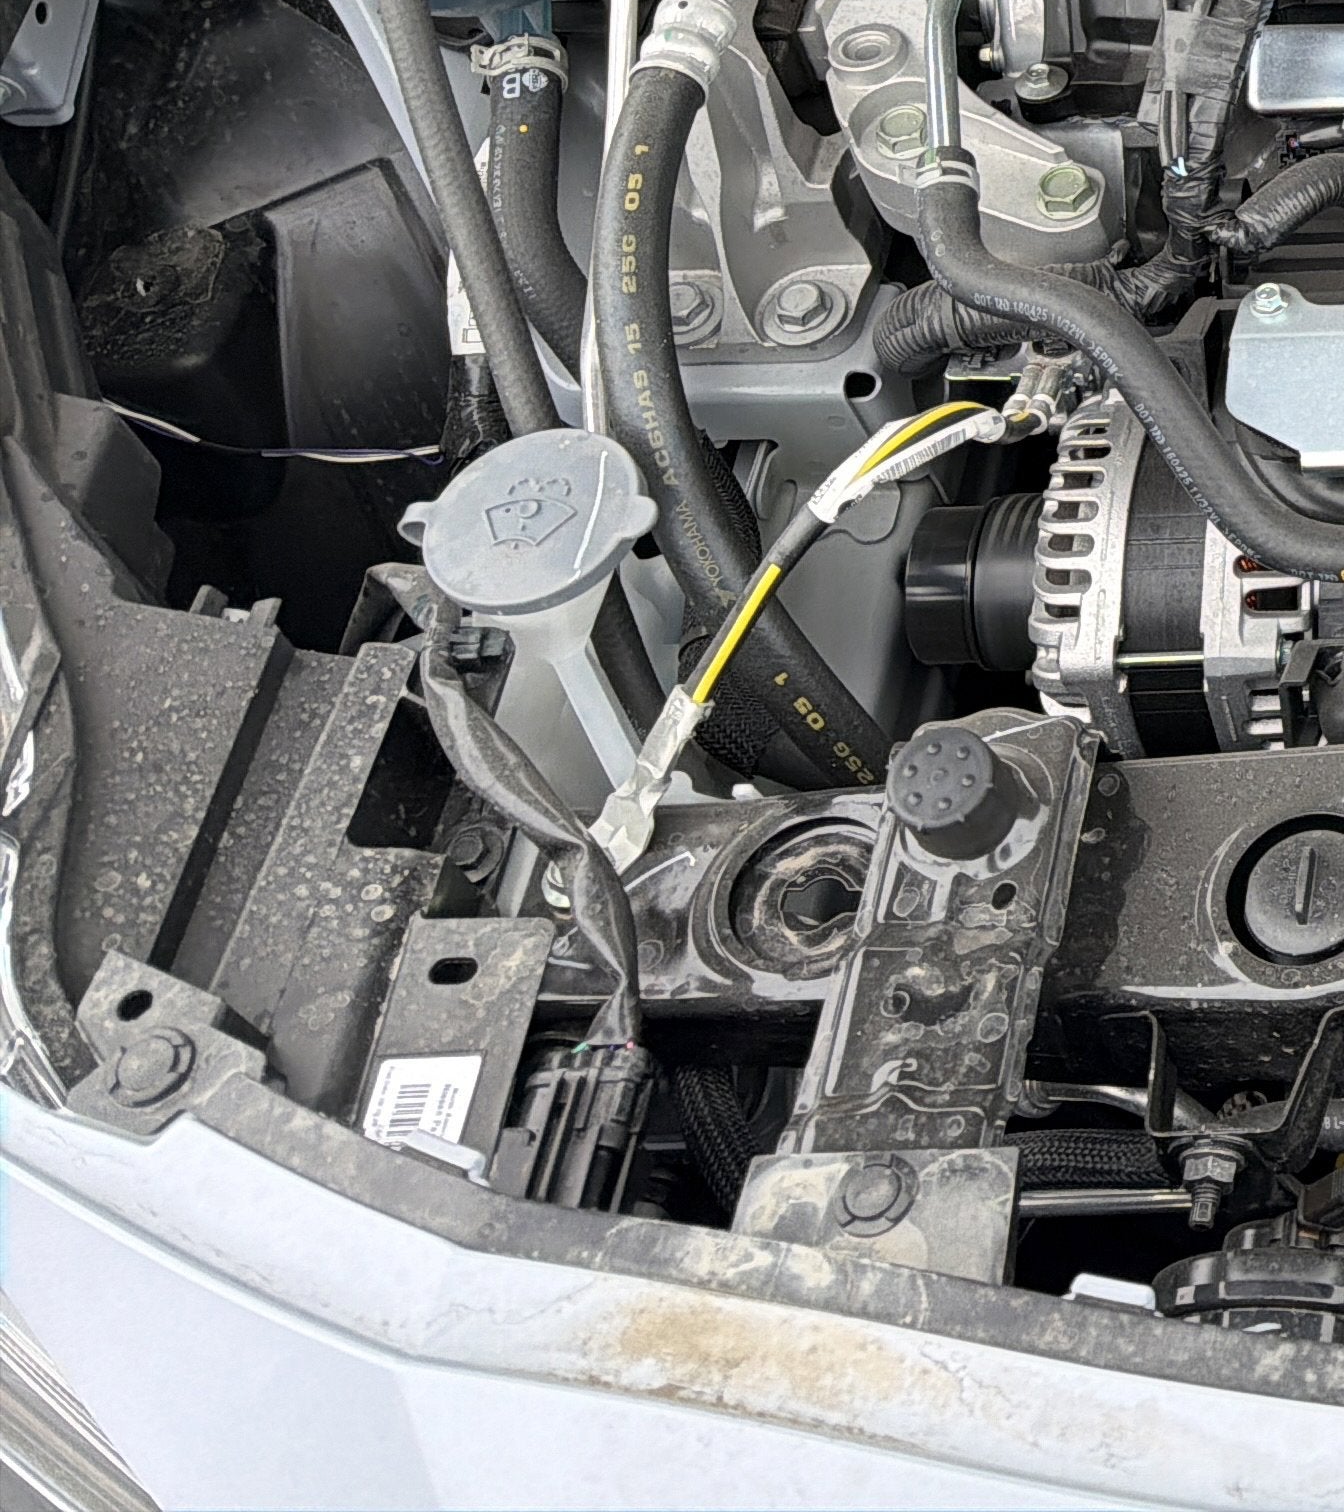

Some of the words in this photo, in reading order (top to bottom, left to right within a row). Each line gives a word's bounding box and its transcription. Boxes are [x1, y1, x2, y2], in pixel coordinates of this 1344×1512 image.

[624, 172, 643, 211] 05
[624, 322, 642, 355] 15
[676, 500, 723, 586] YOKOHAMA
[793, 696, 825, 732] 05
